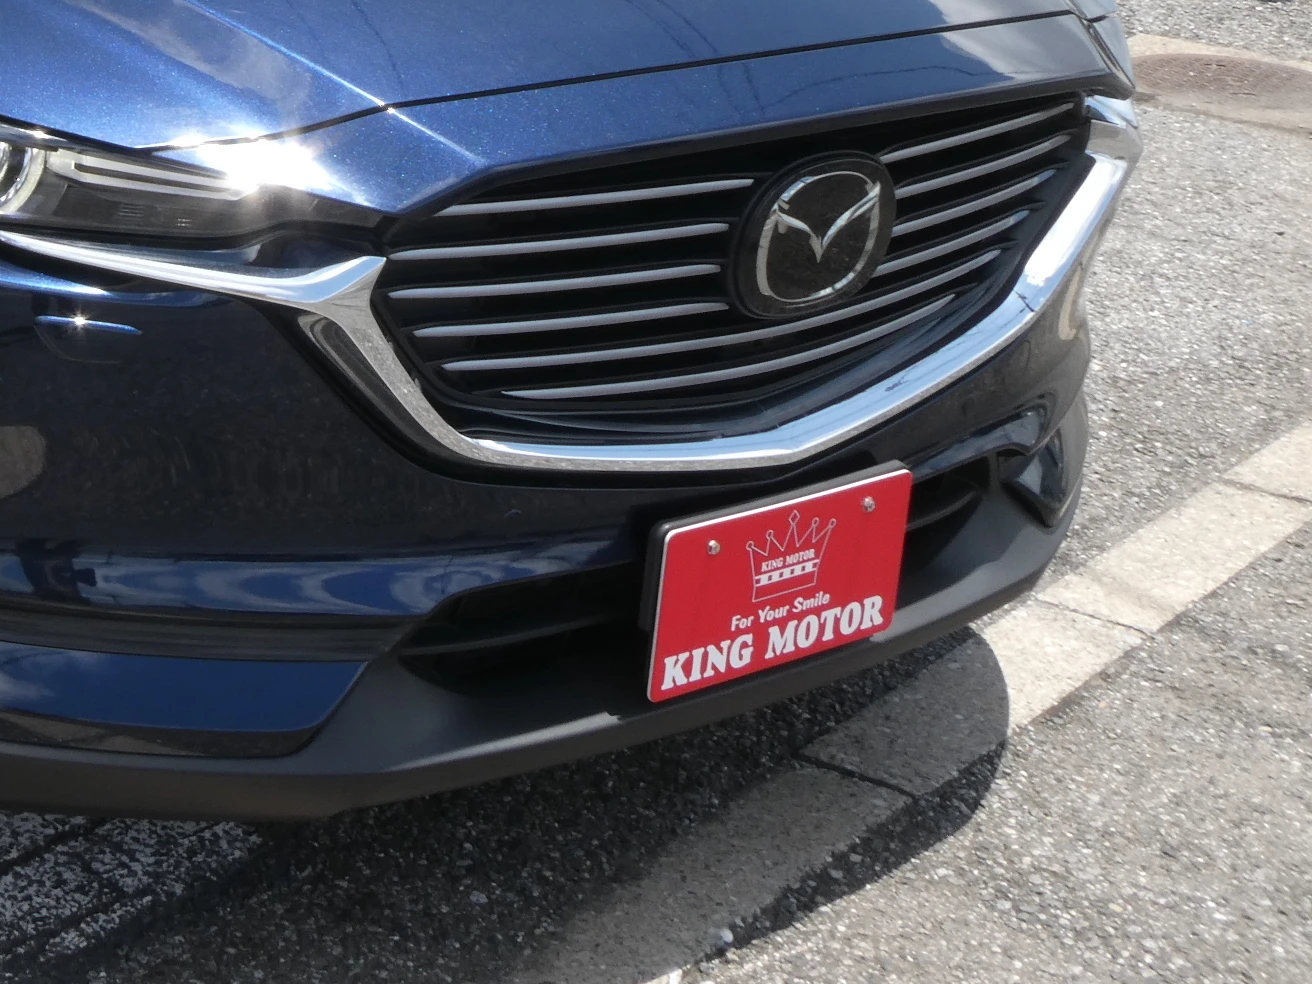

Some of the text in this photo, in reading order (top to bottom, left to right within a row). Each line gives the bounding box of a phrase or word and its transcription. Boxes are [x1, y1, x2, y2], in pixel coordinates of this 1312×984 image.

[761, 548, 815, 572] KING MOTOR
[731, 591, 830, 632] For Your Smile
[660, 595, 884, 691] KING MOTOR
